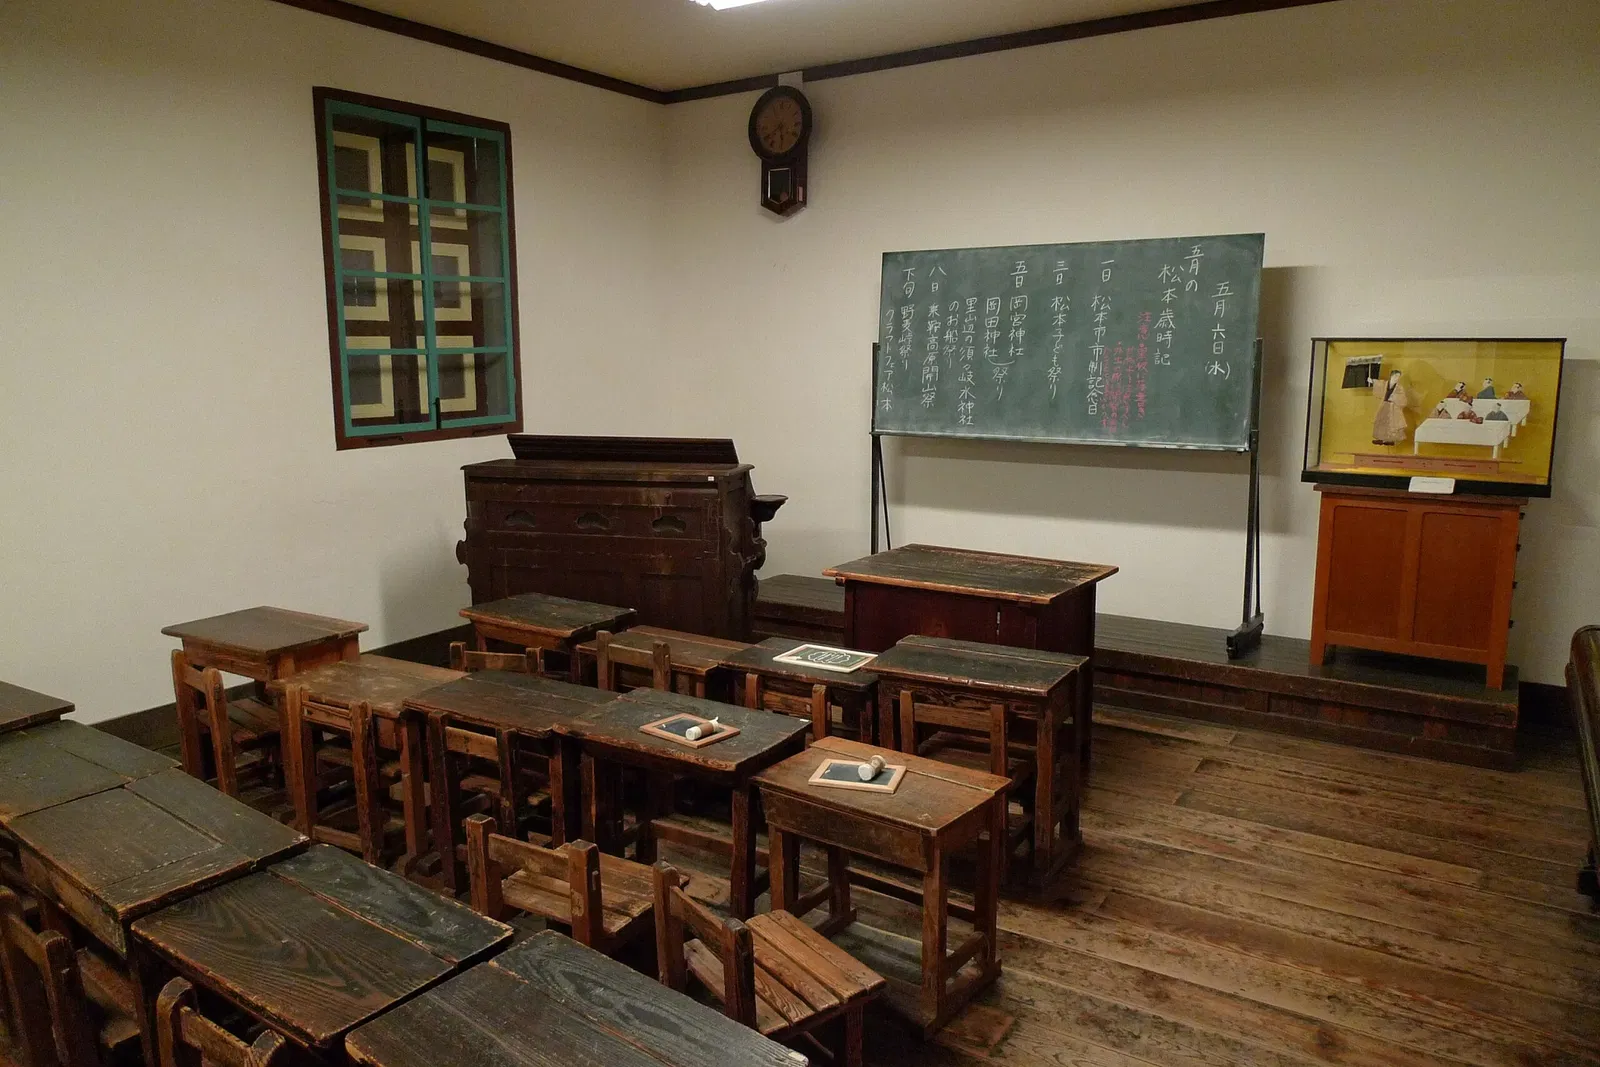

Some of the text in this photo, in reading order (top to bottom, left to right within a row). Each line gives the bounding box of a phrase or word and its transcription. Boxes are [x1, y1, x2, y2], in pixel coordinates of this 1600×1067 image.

[902, 268, 915, 298] 下旬
[928, 266, 947, 293] 八日
[1010, 261, 1028, 288] 五日
[1101, 260, 1114, 283] 一日
[1184, 245, 1205, 292] 五月の
[1047, 261, 1071, 400] 三日 松本子ども祭り
[1154, 264, 1184, 366] 松本歳時記
[880, 310, 895, 411] クラフトフェア松本
[1087, 295, 1111, 415] 松本市市制記念日
